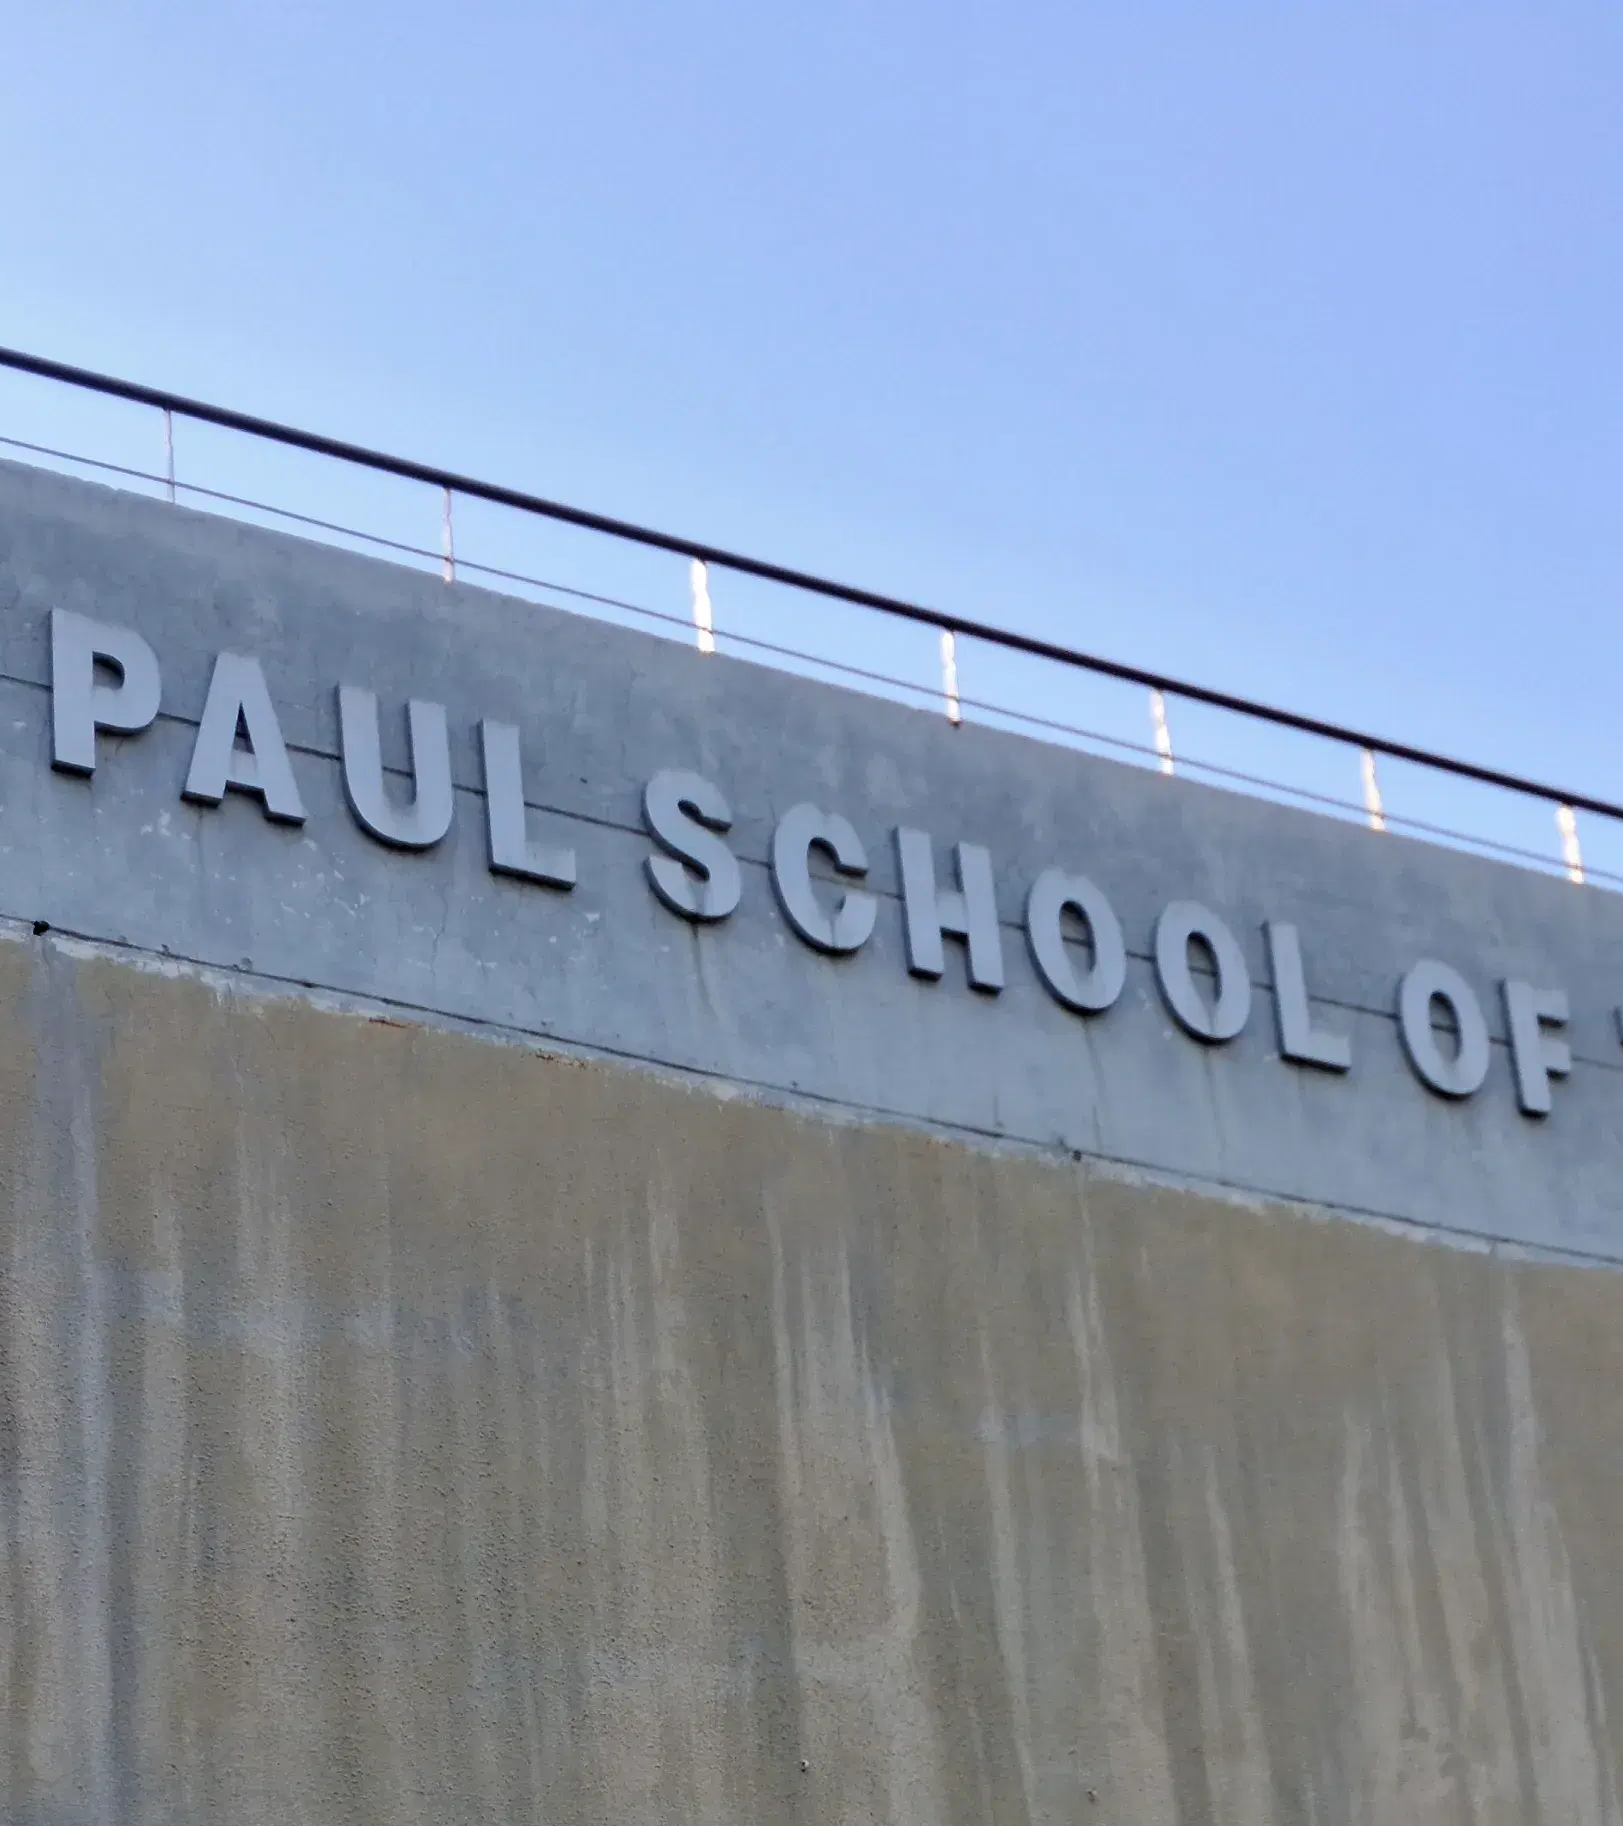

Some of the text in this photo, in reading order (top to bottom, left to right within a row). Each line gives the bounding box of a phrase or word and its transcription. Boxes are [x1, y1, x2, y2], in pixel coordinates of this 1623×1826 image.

[49, 606, 576, 891] PAUL
[641, 767, 1352, 1074] SCHOOL
[1397, 958, 1573, 1120] OF
